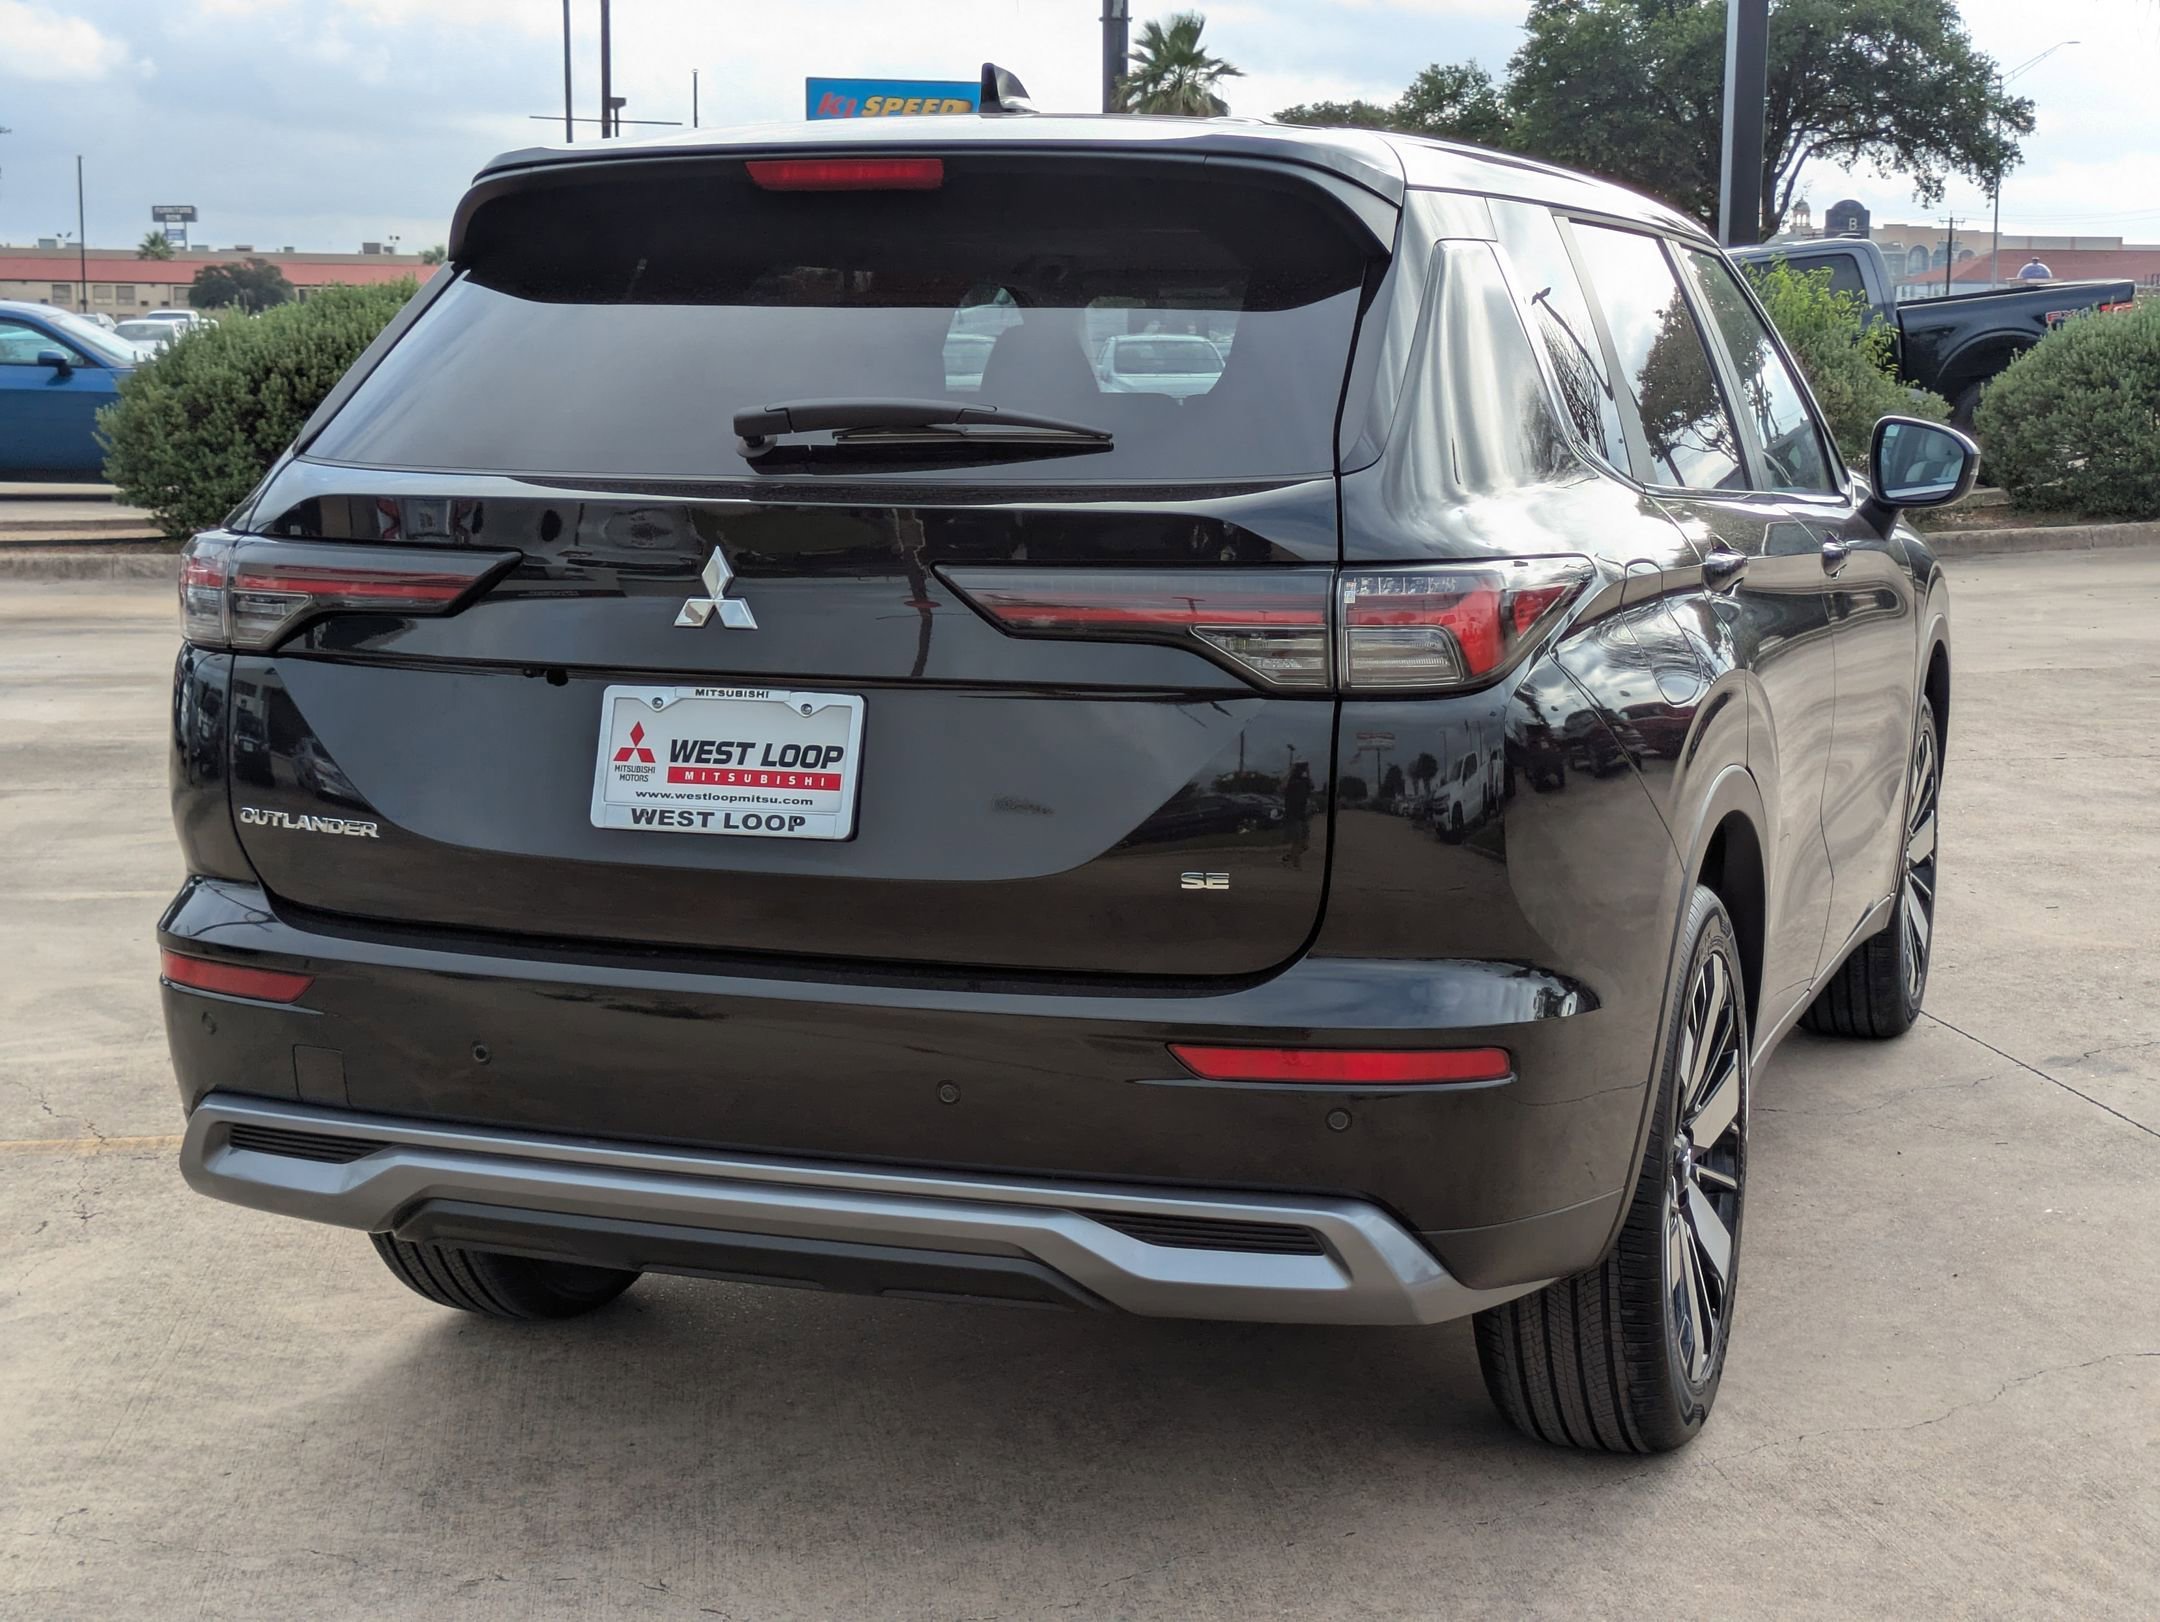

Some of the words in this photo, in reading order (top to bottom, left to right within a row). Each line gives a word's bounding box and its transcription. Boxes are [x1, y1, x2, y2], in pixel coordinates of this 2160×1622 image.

[861, 96, 973, 116] SPEED
[694, 688, 770, 699] MITSUBISHI
[669, 738, 757, 766] WEST
[760, 742, 845, 769] LOOP
[614, 764, 656, 775] MITSUBISHI
[618, 773, 649, 783] MOTORS
[684, 770, 826, 787] MITSUBISHI
[635, 790, 814, 806] www.westloopmitsu.com
[239, 806, 380, 838] OUTLANDER
[630, 807, 715, 828] WEST
[722, 811, 807, 832] LOOP
[1180, 871, 1230, 890] SE
